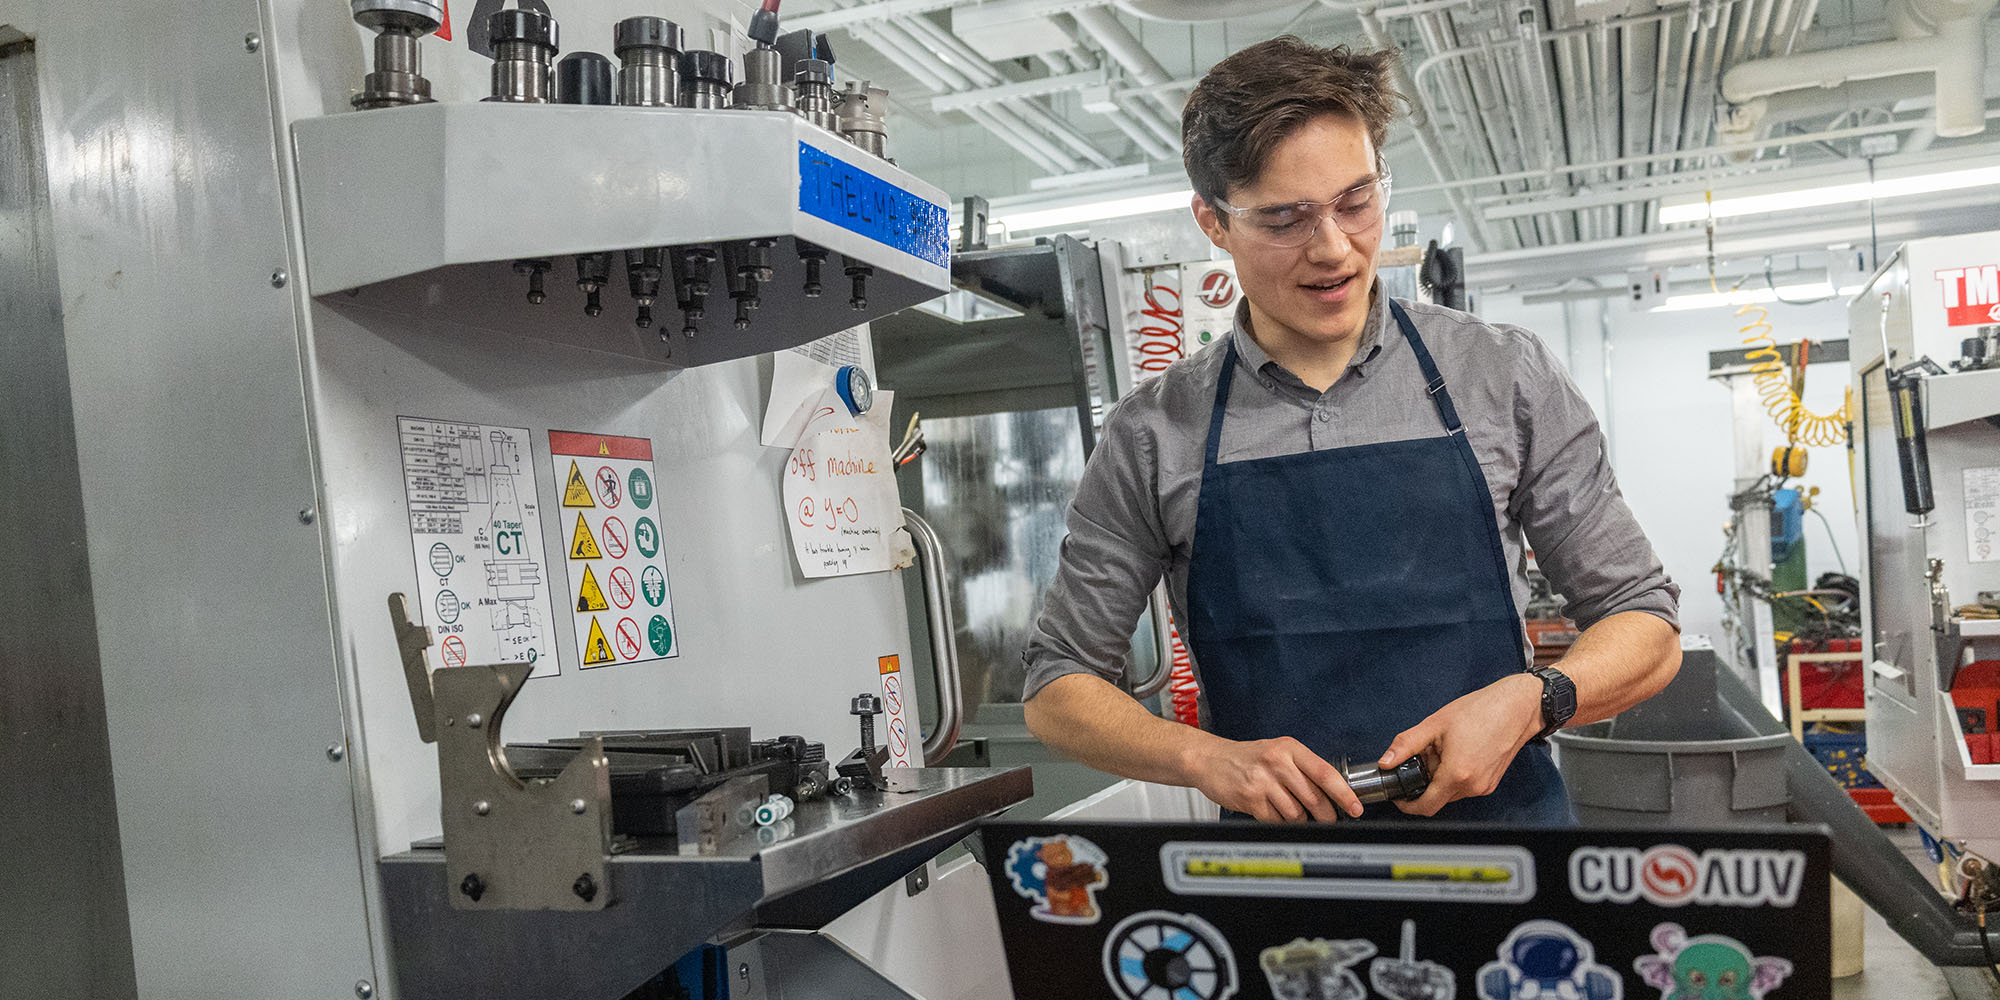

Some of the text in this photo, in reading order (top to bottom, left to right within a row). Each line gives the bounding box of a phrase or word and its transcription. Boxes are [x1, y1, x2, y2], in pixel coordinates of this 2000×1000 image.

[514, 454, 520, 462] D
[798, 496, 815, 527] @
[493, 520, 522, 531] 40 Taper
[478, 527, 484, 536] C
[496, 530, 523, 556] CT
[455, 555, 466, 563] OK
[440, 578, 449, 587] CT
[461, 602, 472, 610] OK
[478, 597, 498, 606] A Max
[438, 624, 464, 634] DIN ISO
[1579, 855, 1633, 894] CU
